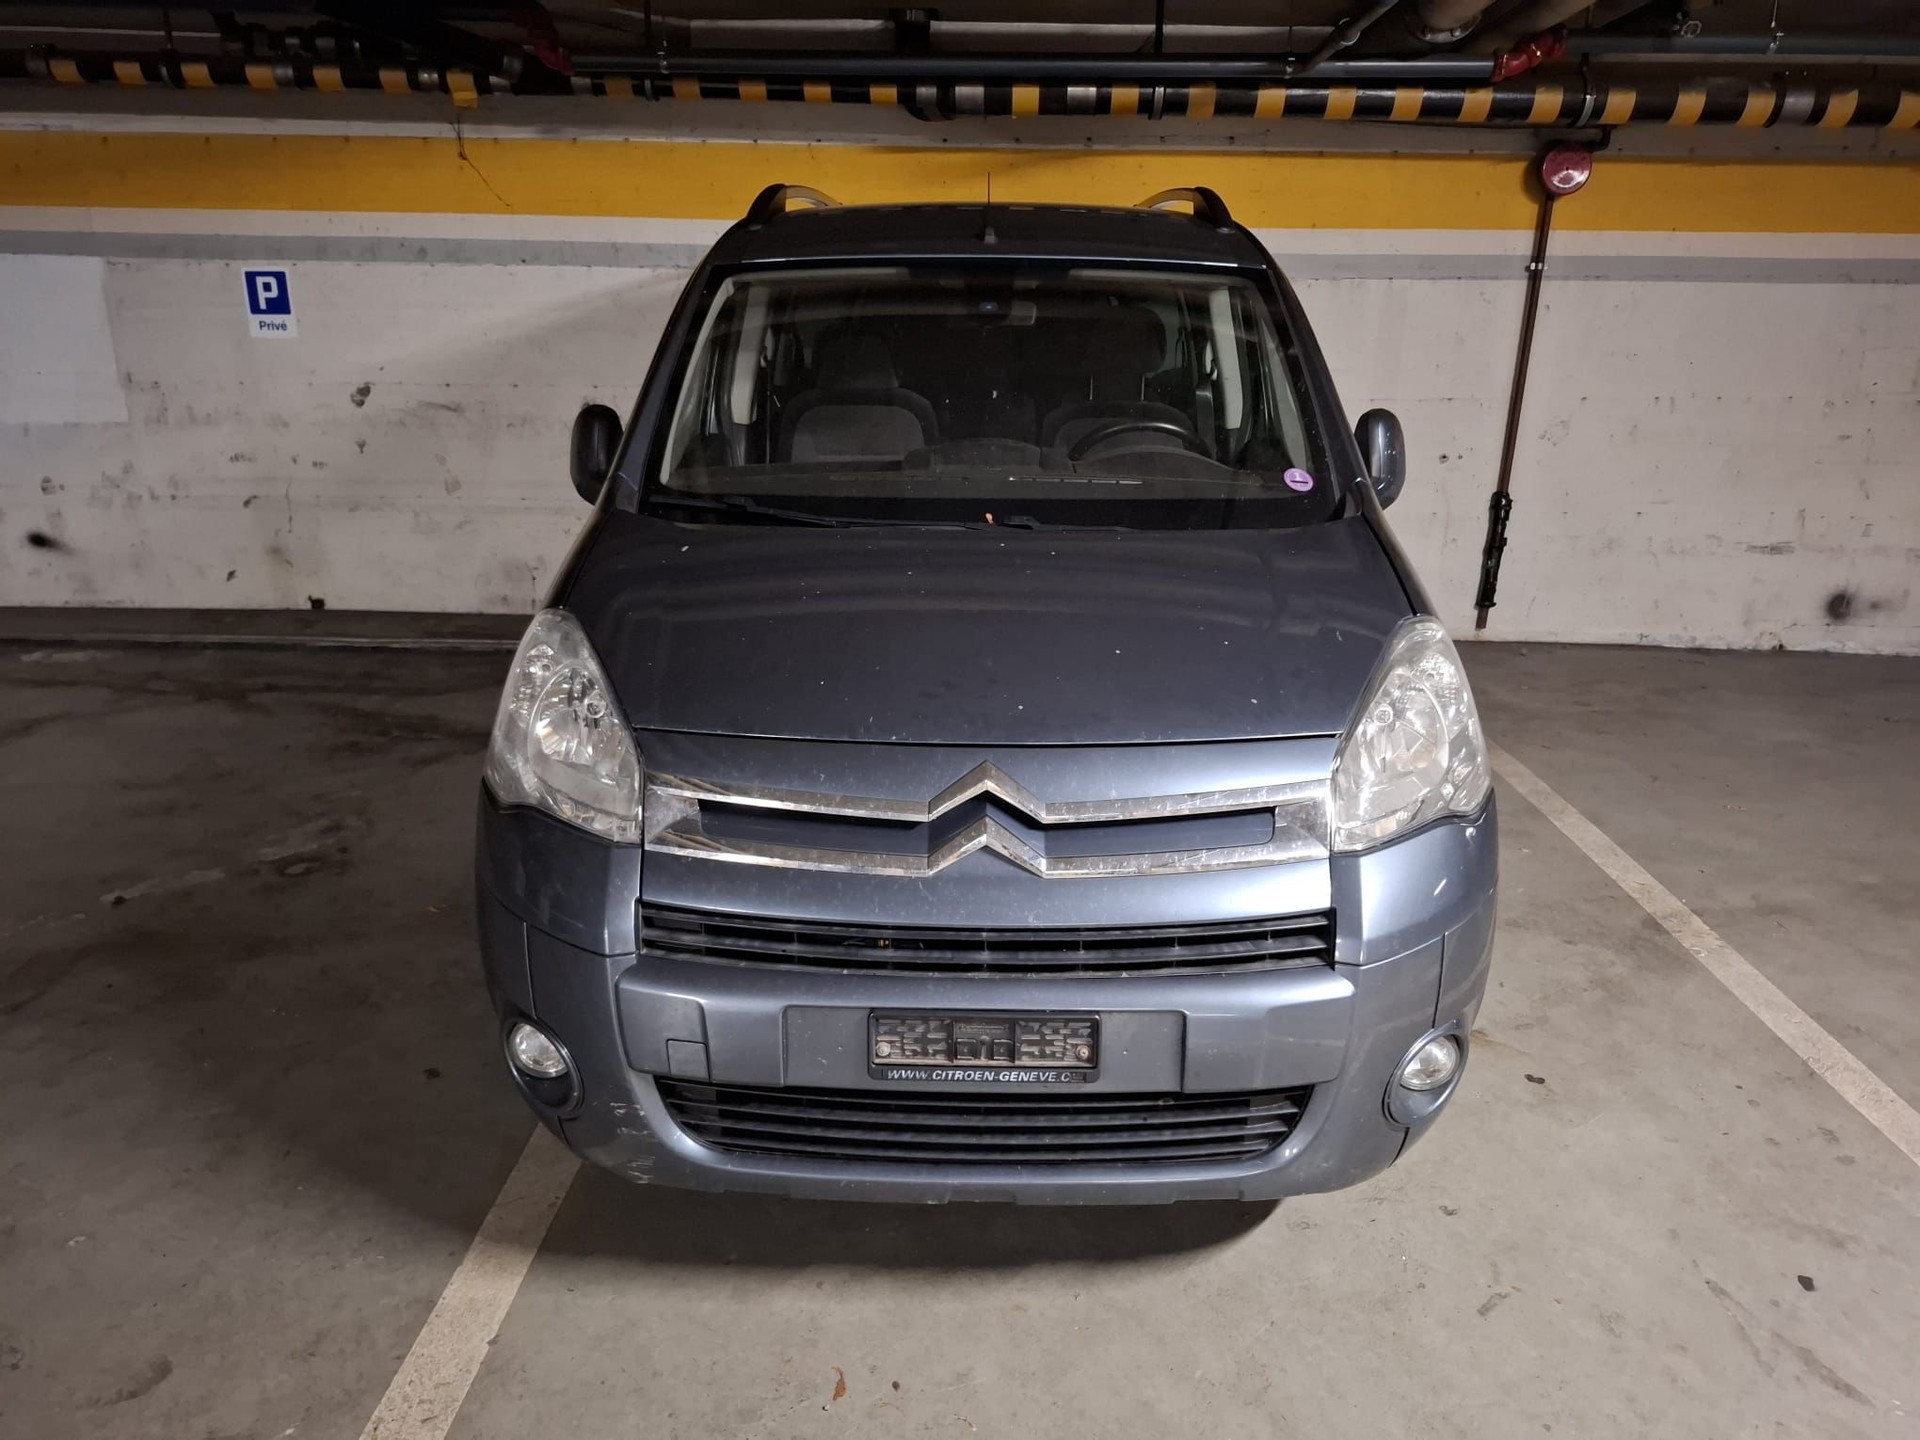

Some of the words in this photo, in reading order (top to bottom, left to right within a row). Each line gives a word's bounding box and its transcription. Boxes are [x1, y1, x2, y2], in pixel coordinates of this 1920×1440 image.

[255, 275, 279, 310] P
[258, 319, 288, 332] Privé
[887, 1069, 1083, 1083] WWW.CITROEN-GENEVE.C
